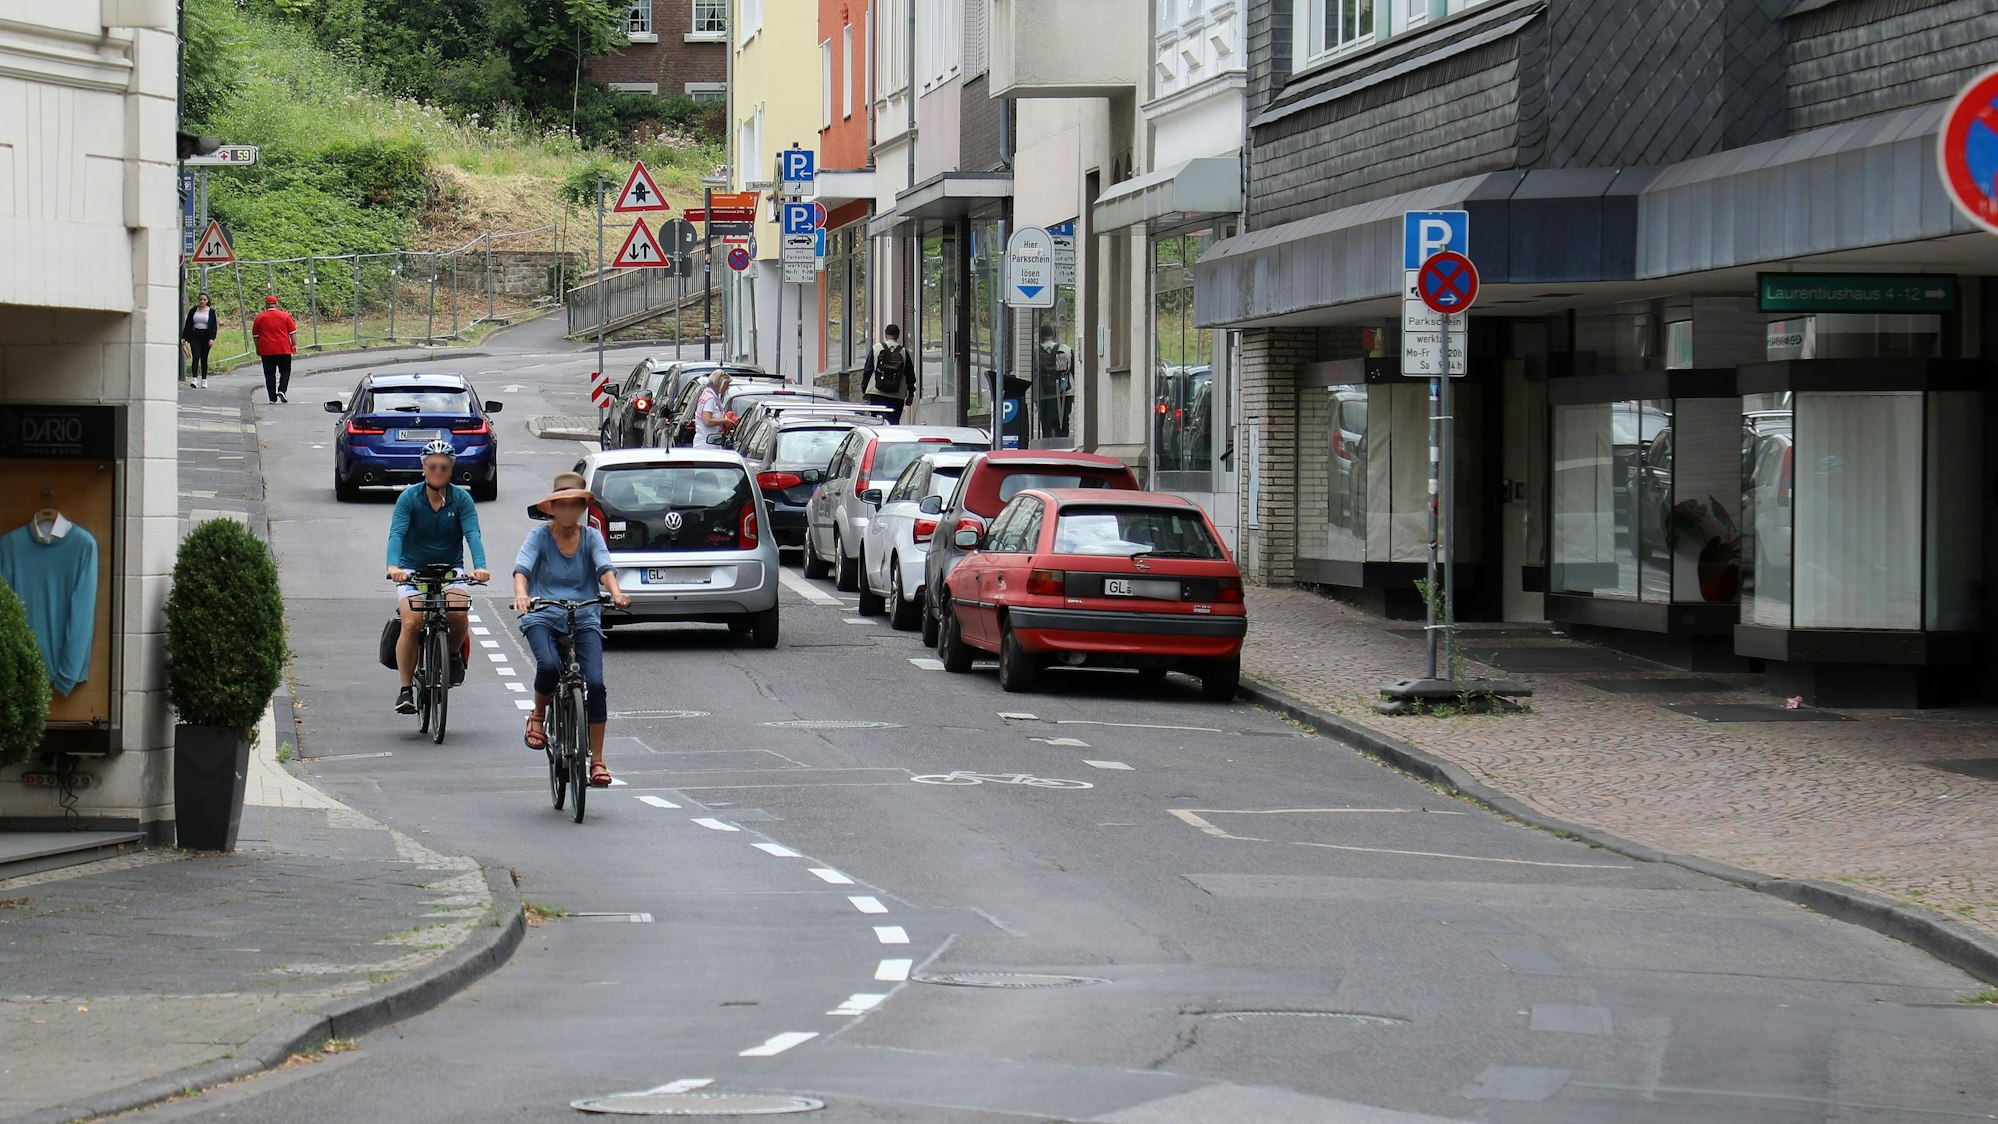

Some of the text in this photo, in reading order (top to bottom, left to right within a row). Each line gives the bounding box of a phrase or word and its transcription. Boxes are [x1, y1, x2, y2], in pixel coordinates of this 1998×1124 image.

[237, 151, 249, 160] 59
[791, 154, 807, 178] P
[791, 207, 808, 231] P
[1420, 220, 1453, 266] P
[1012, 254, 1050, 263] Parkschein
[1021, 269, 1040, 277] lösen
[1766, 286, 1881, 300] Laurentiushaus
[1408, 317, 1462, 326] Parkscein
[1417, 335, 1453, 343] werkts
[1406, 348, 1463, 357] Mo-Fr 20h
[1420, 361, 1430, 369] Sa
[1002, 401, 1013, 419] P
